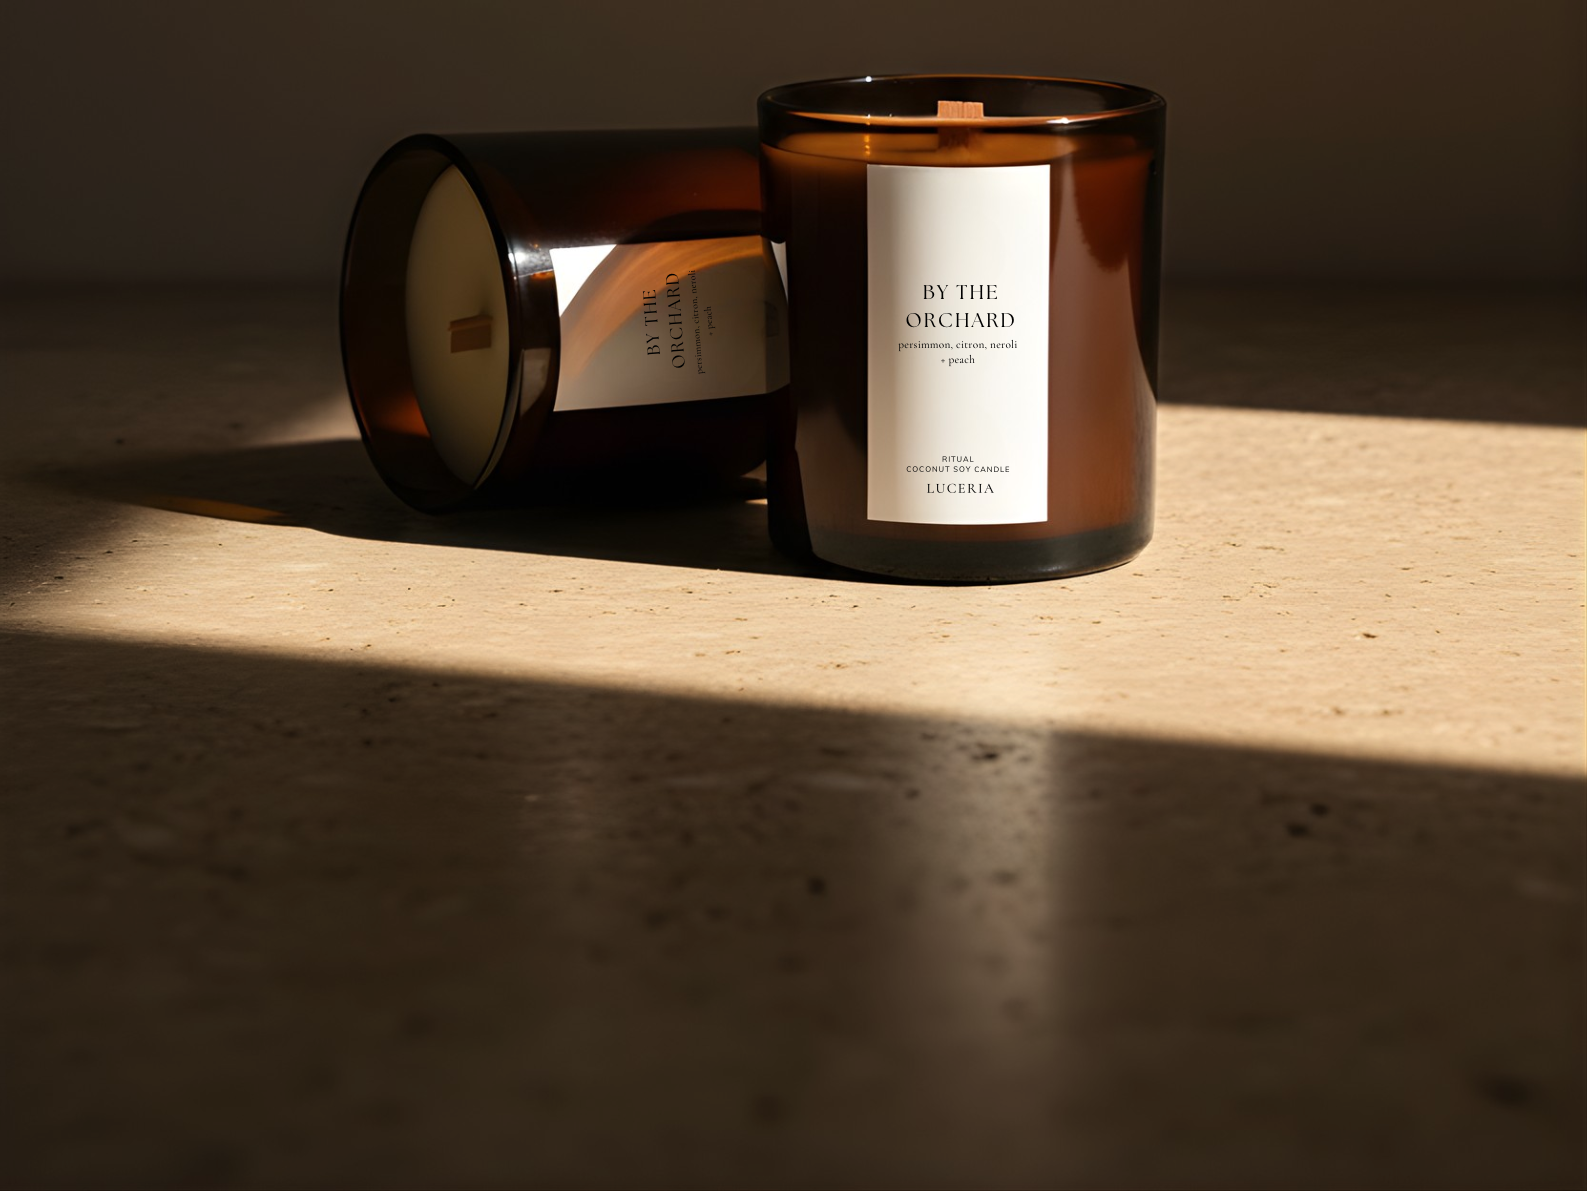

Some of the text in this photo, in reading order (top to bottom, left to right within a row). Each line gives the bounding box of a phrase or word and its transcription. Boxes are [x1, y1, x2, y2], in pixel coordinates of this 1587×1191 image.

[687, 270, 698, 294] neroli
[923, 284, 998, 300] BY THE
[642, 289, 661, 355] BY THE
[665, 273, 686, 369] ORCHARD
[703, 306, 716, 330] peach
[905, 312, 1015, 328] ORCHARD
[898, 340, 1018, 352] persimmon, citron, neroli
[948, 355, 975, 367] peach
[941, 455, 974, 463] RITUAL
[906, 465, 1010, 473] COCONUT SOY CANDLE
[926, 483, 995, 494] LUCERIA
